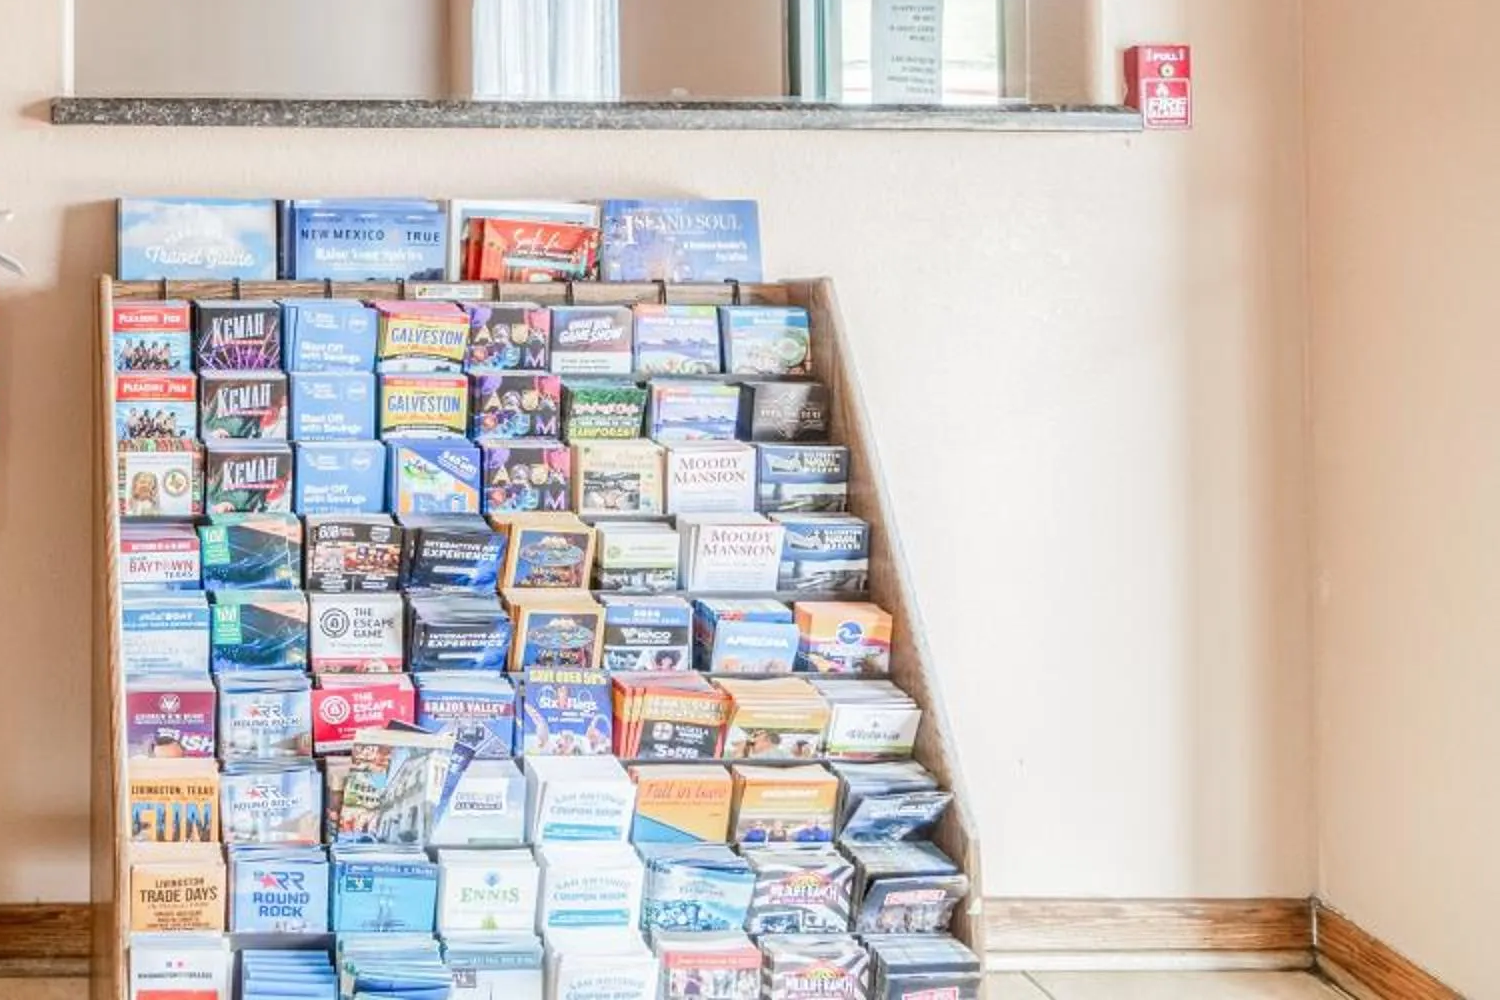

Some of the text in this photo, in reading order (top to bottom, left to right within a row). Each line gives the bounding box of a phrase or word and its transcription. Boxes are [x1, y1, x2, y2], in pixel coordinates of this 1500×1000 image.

[1148, 98, 1187, 110] FIRE
[697, 214, 743, 230] SOUL
[301, 229, 440, 242] NEW MEXICO TRUE
[145, 245, 255, 268] Travel Guide
[211, 313, 265, 346] KEMAH
[391, 328, 464, 345] GALVESTON
[215, 383, 271, 417] KEMAH
[387, 392, 460, 412] GALVESTON
[678, 457, 740, 470] MOODY
[222, 457, 278, 489] KEMAH
[674, 471, 746, 484] MANSION
[711, 529, 773, 542] MOODY
[423, 549, 497, 561] EXPERIENCE
[703, 544, 776, 557] MANSION
[353, 608, 372, 616] THE
[353, 619, 395, 629] ESCAPE
[353, 630, 383, 638] GAME
[428, 638, 504, 648] EXPERIENCE
[352, 692, 373, 700] THE
[353, 700, 394, 712] ESCAPE
[423, 702, 506, 713] BRAZOS VALLEY
[539, 696, 598, 713] Six Flags
[354, 712, 384, 722] GAME
[186, 785, 214, 795] TEXAS
[131, 801, 210, 842] FUN
[140, 886, 217, 902] TRADE DAYS
[253, 892, 310, 904] ROUND
[460, 887, 520, 903] ENNIS
[259, 906, 303, 917] ROCK
